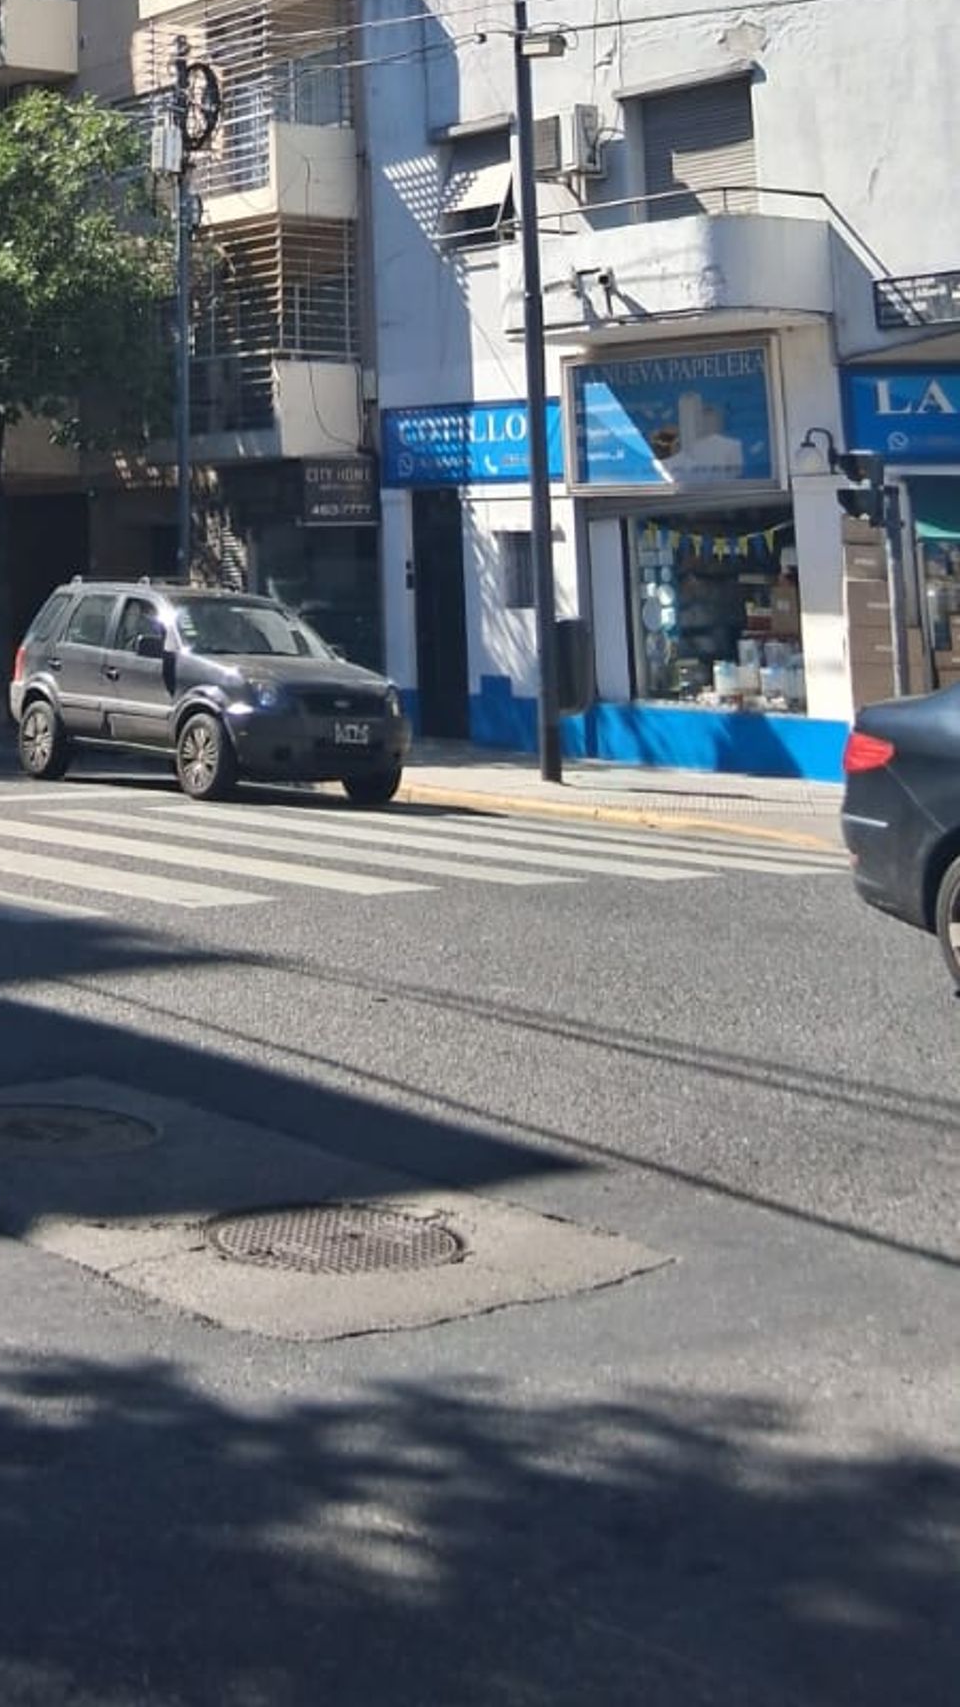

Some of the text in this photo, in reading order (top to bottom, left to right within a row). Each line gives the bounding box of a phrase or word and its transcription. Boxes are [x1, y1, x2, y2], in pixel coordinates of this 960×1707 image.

[604, 360, 665, 385] NUEVA
[670, 349, 765, 380] PAPELERA
[876, 380, 958, 414] LA
[398, 413, 527, 446] COTILLO
